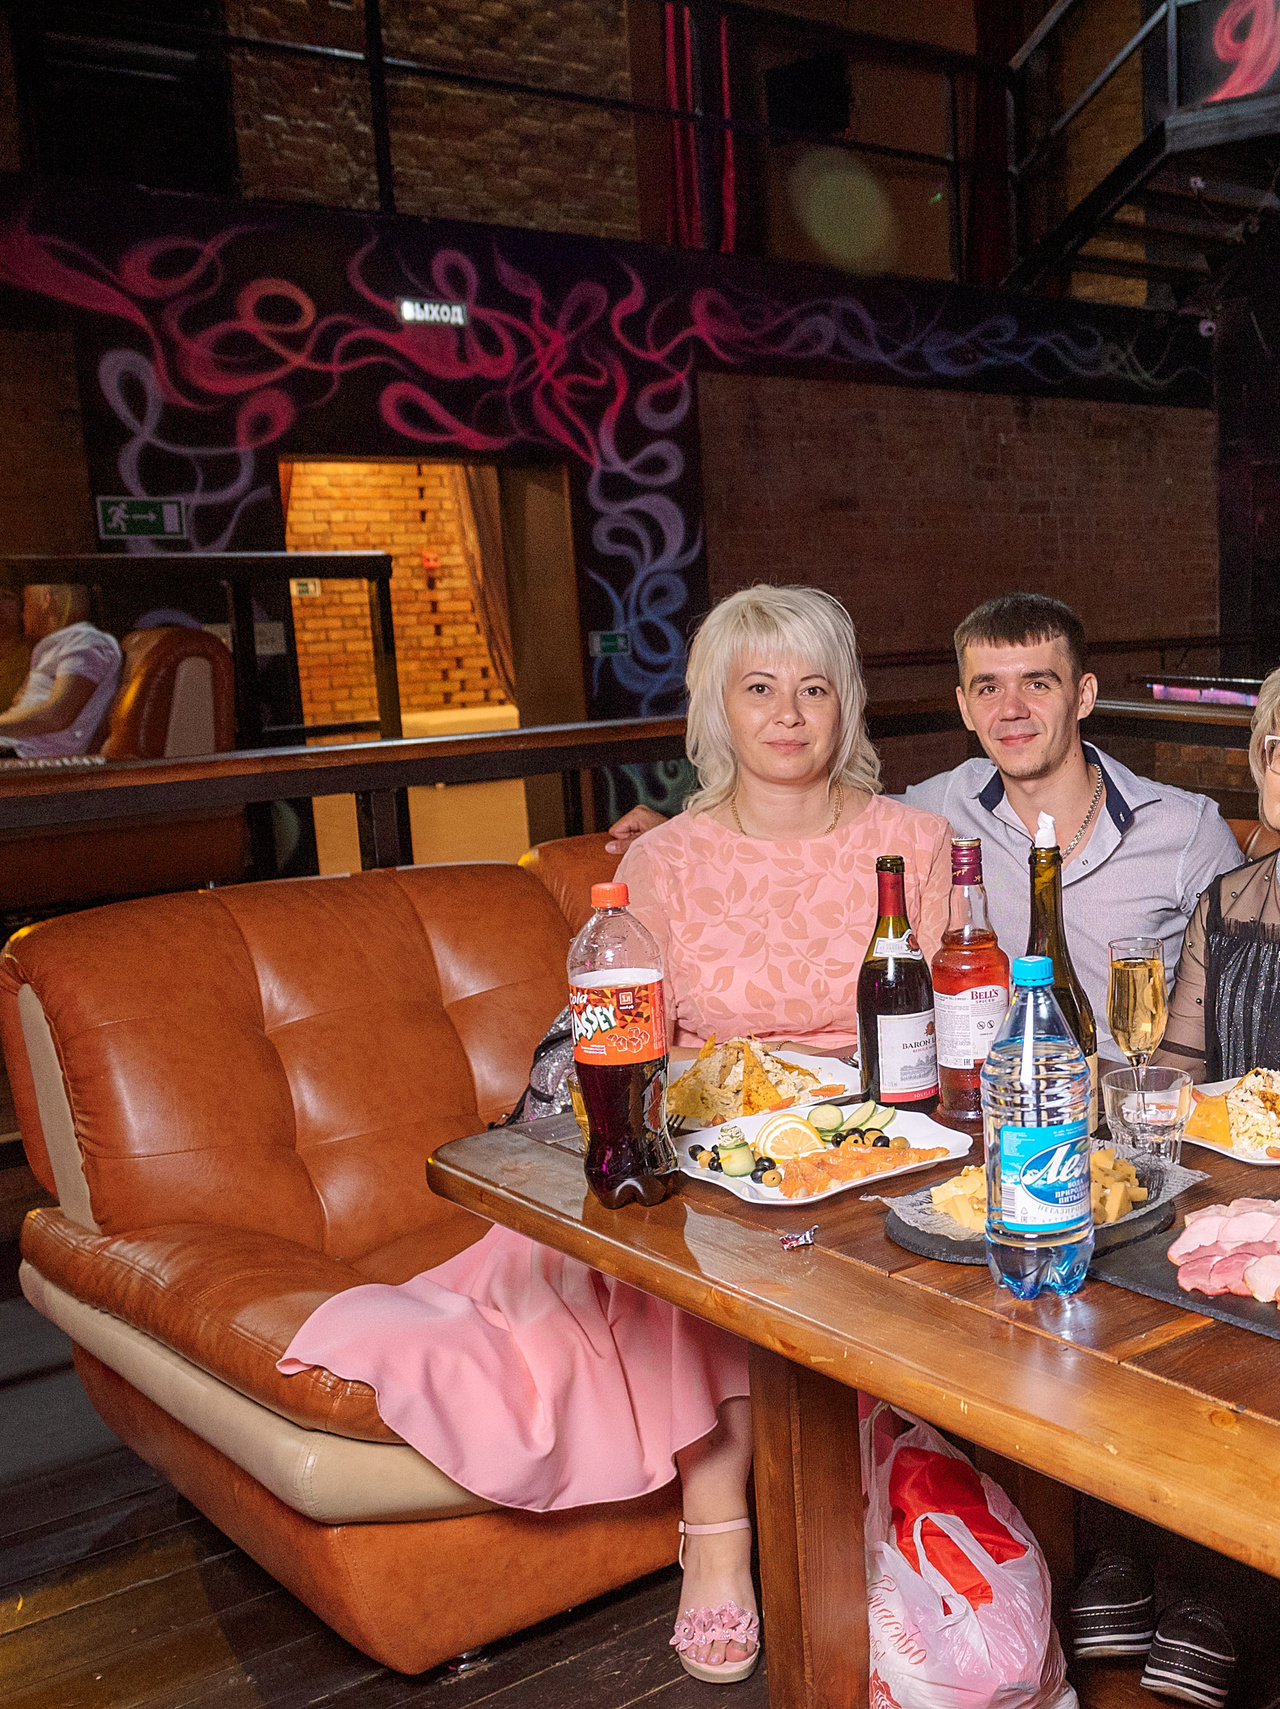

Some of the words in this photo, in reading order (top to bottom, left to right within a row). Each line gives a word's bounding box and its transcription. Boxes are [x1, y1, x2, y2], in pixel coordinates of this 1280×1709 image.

[401, 301, 464, 326] ВЫХОД
[971, 989, 999, 1000] BELL'S
[902, 1038, 931, 1050] BARON
